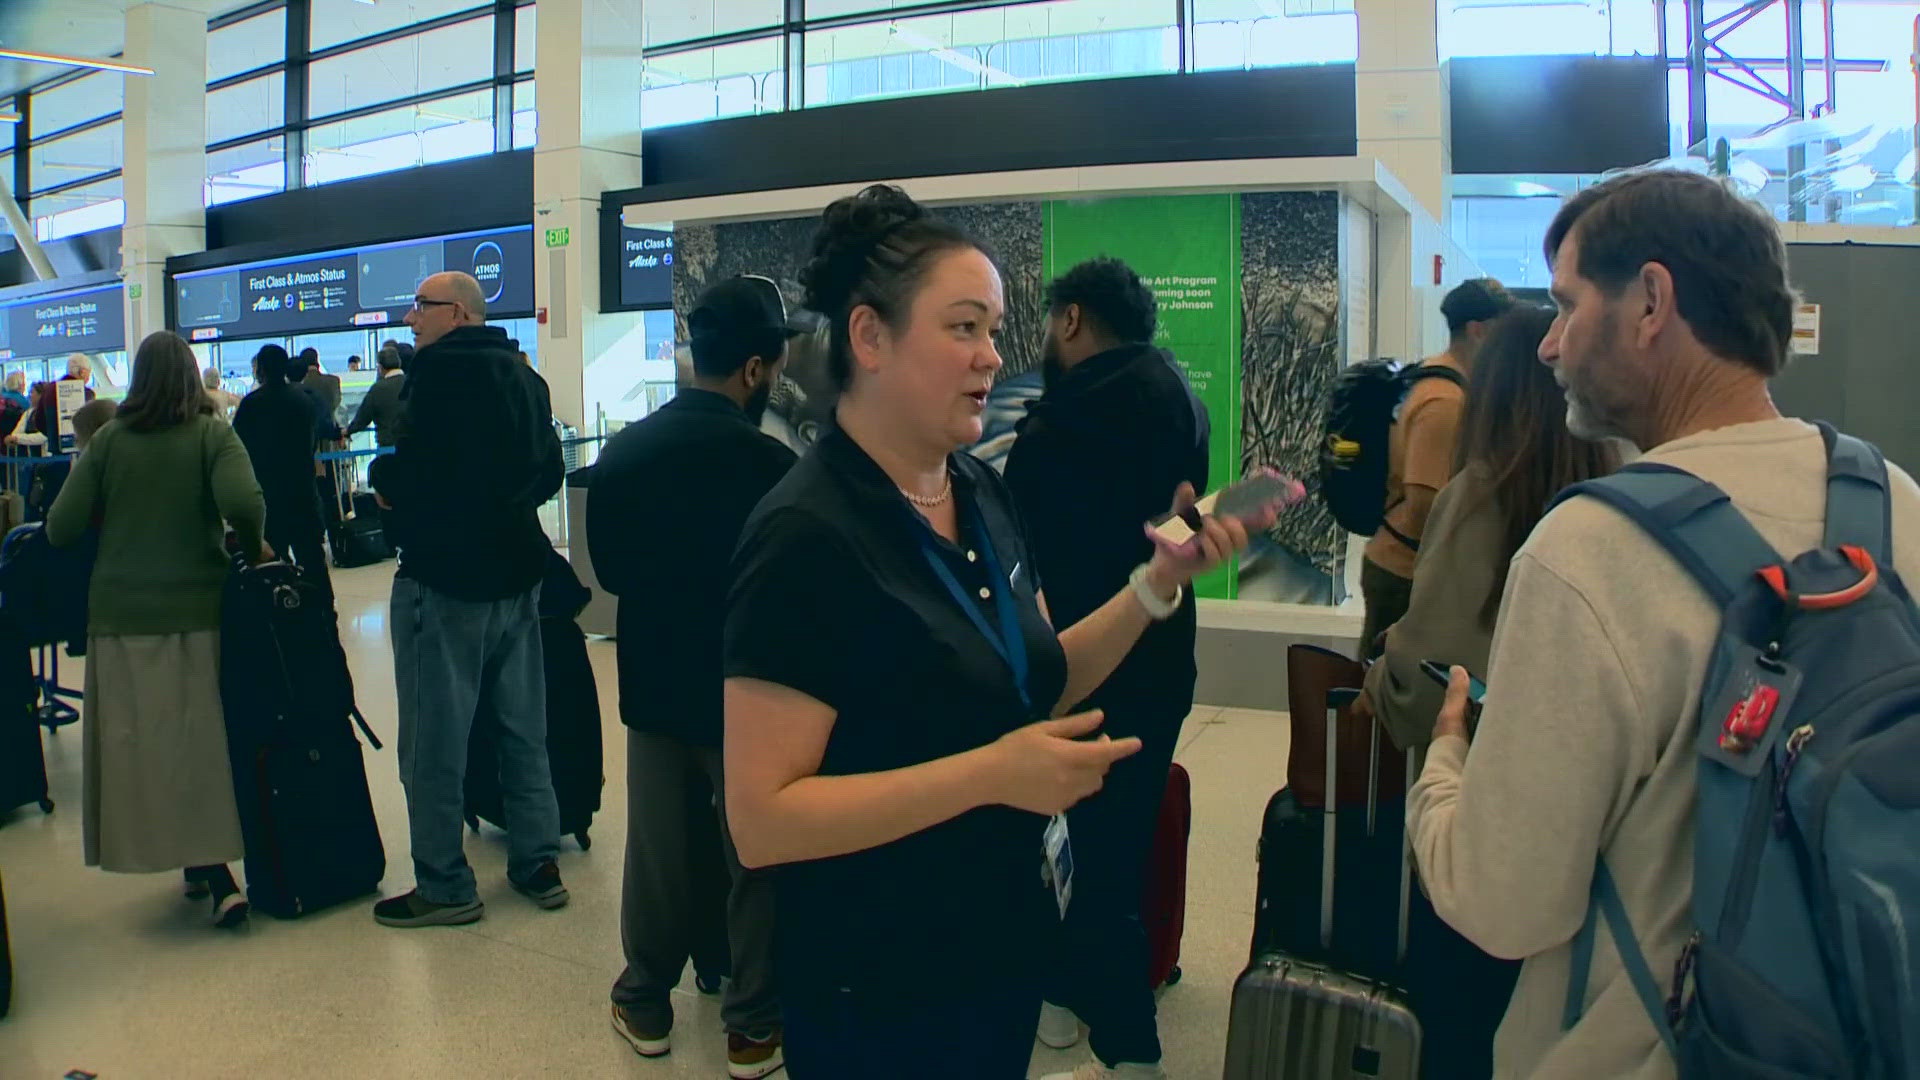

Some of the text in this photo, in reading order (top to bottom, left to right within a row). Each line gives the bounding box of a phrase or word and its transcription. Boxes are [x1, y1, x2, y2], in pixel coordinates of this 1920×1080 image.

[549, 230, 566, 246] EXIT
[626, 236, 673, 252] First Class &
[628, 254, 659, 268] Alaska
[475, 263, 500, 275] ATMOS
[249, 267, 346, 291] First Class & Atmos Status
[1154, 276, 1171, 286] Art
[1172, 276, 1217, 287] Program
[1152, 287, 1211, 299] oming soon
[252, 296, 281, 312] Alaska
[1169, 300, 1214, 310] Johnson
[1188, 369, 1212, 379] have
